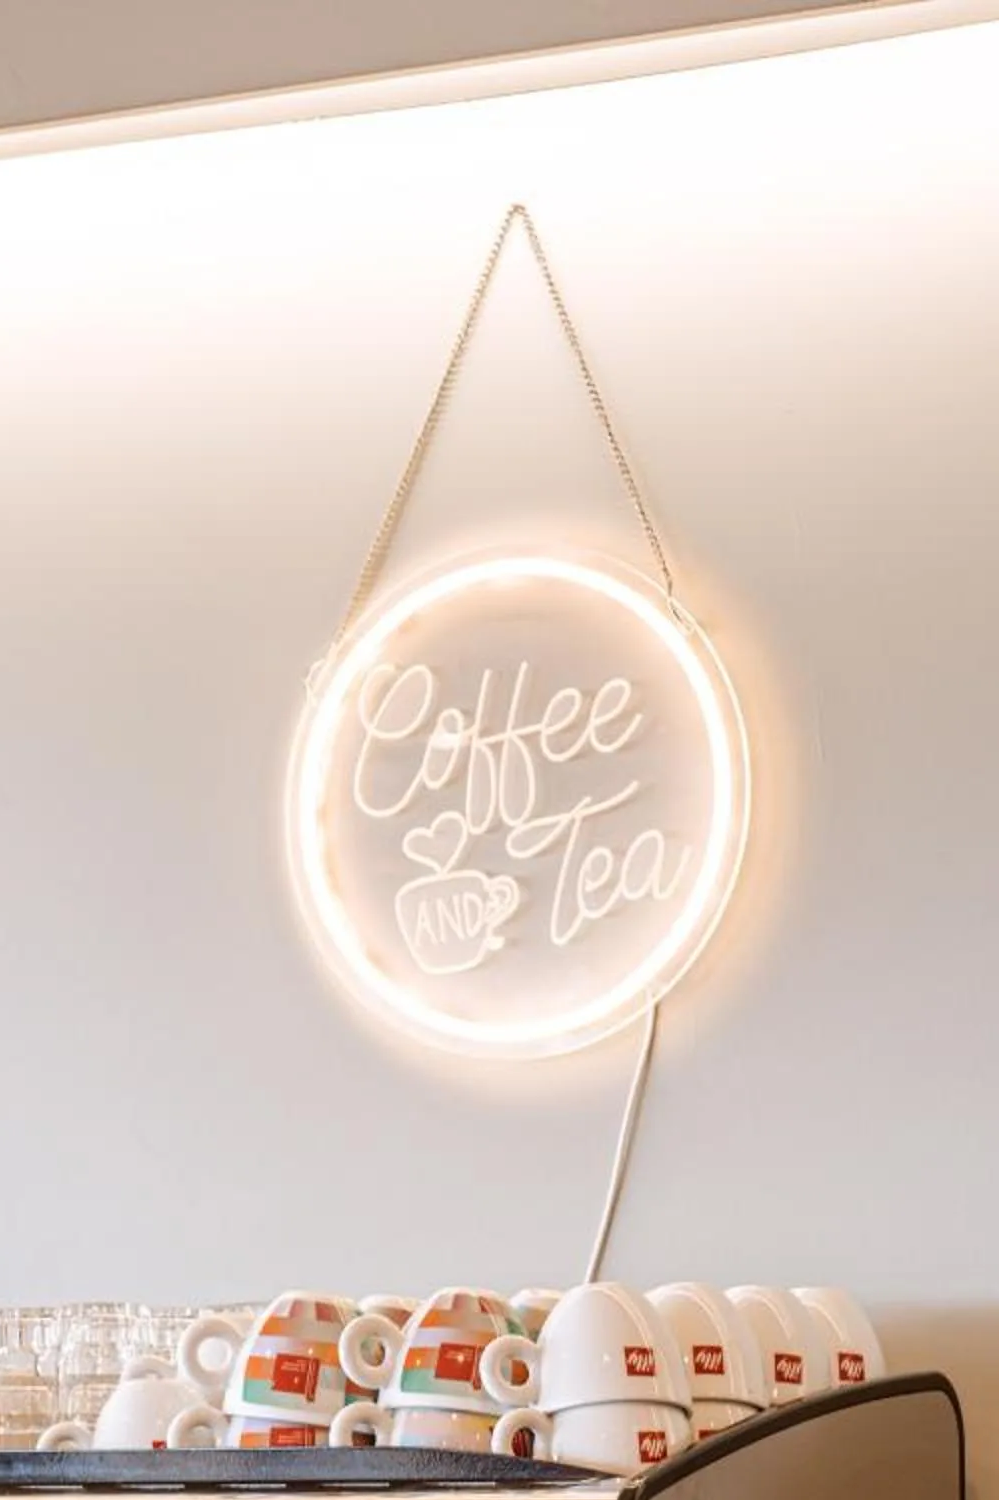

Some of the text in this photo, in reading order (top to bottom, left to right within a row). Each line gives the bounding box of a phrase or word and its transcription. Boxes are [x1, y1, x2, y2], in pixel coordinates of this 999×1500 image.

[354, 661, 643, 835] Coffee
[414, 892, 487, 948] AND
[505, 780, 693, 946] Tea
